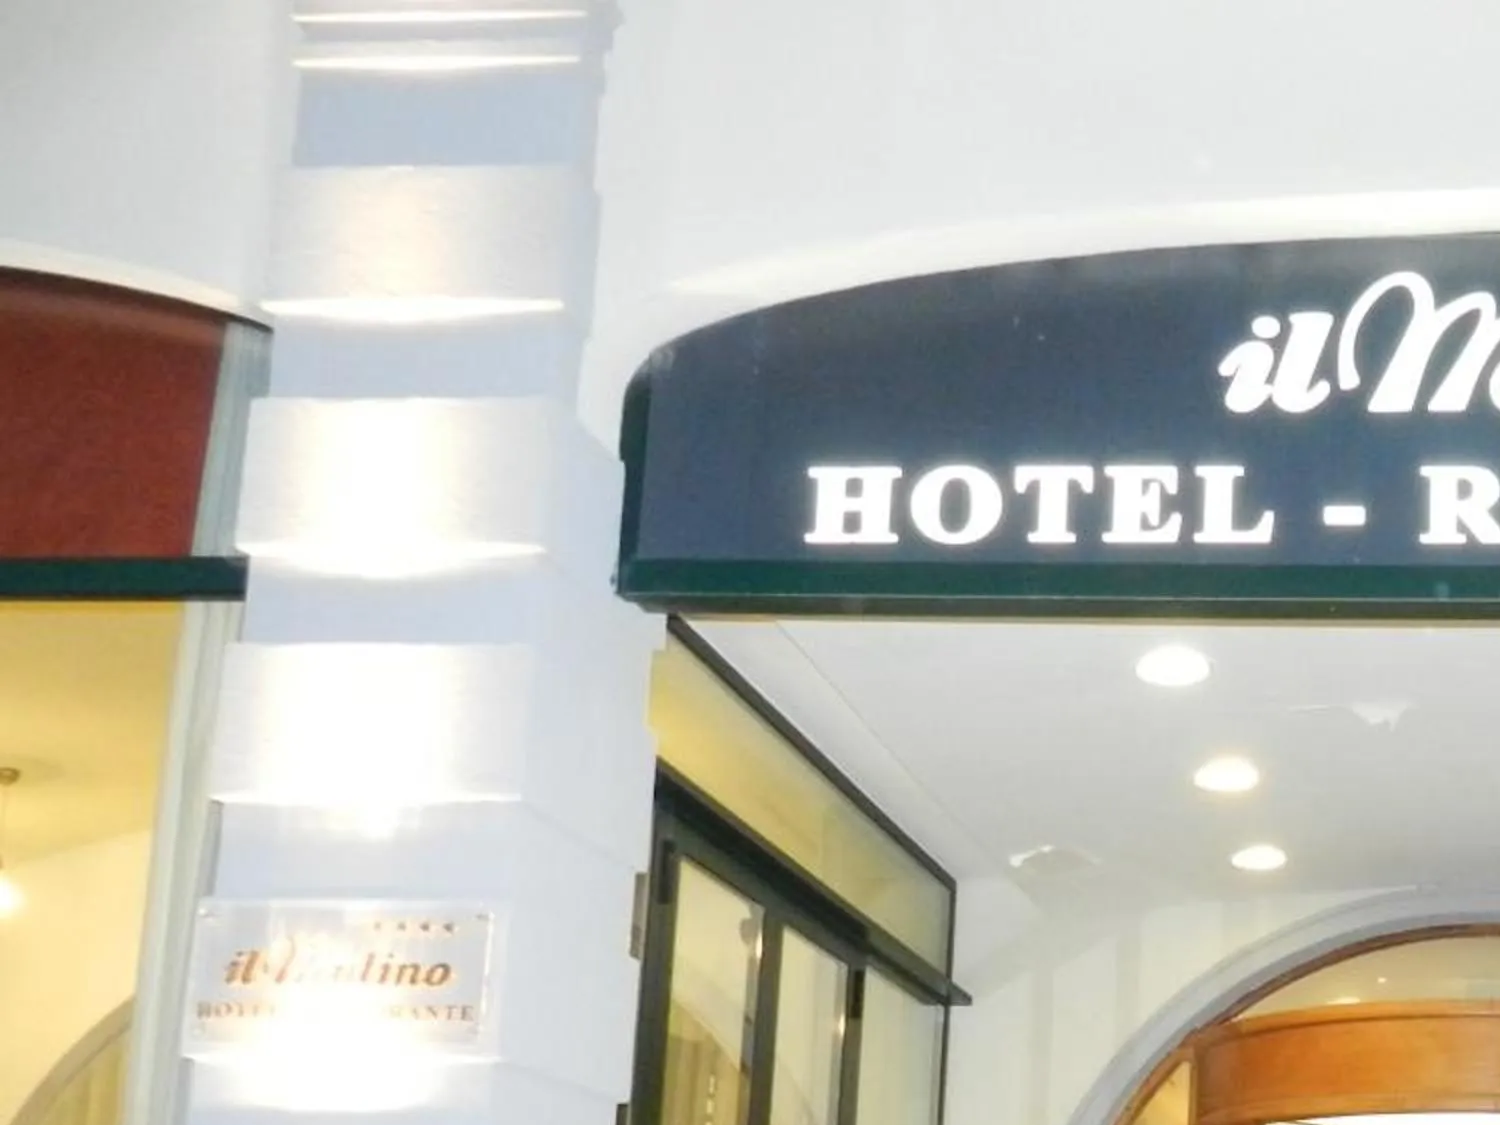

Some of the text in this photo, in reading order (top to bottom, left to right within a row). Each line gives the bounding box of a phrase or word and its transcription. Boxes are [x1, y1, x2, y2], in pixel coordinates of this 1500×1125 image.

[1217, 310, 1335, 414] il
[803, 464, 1275, 546] HOTEL
[263, 934, 453, 987] lino
